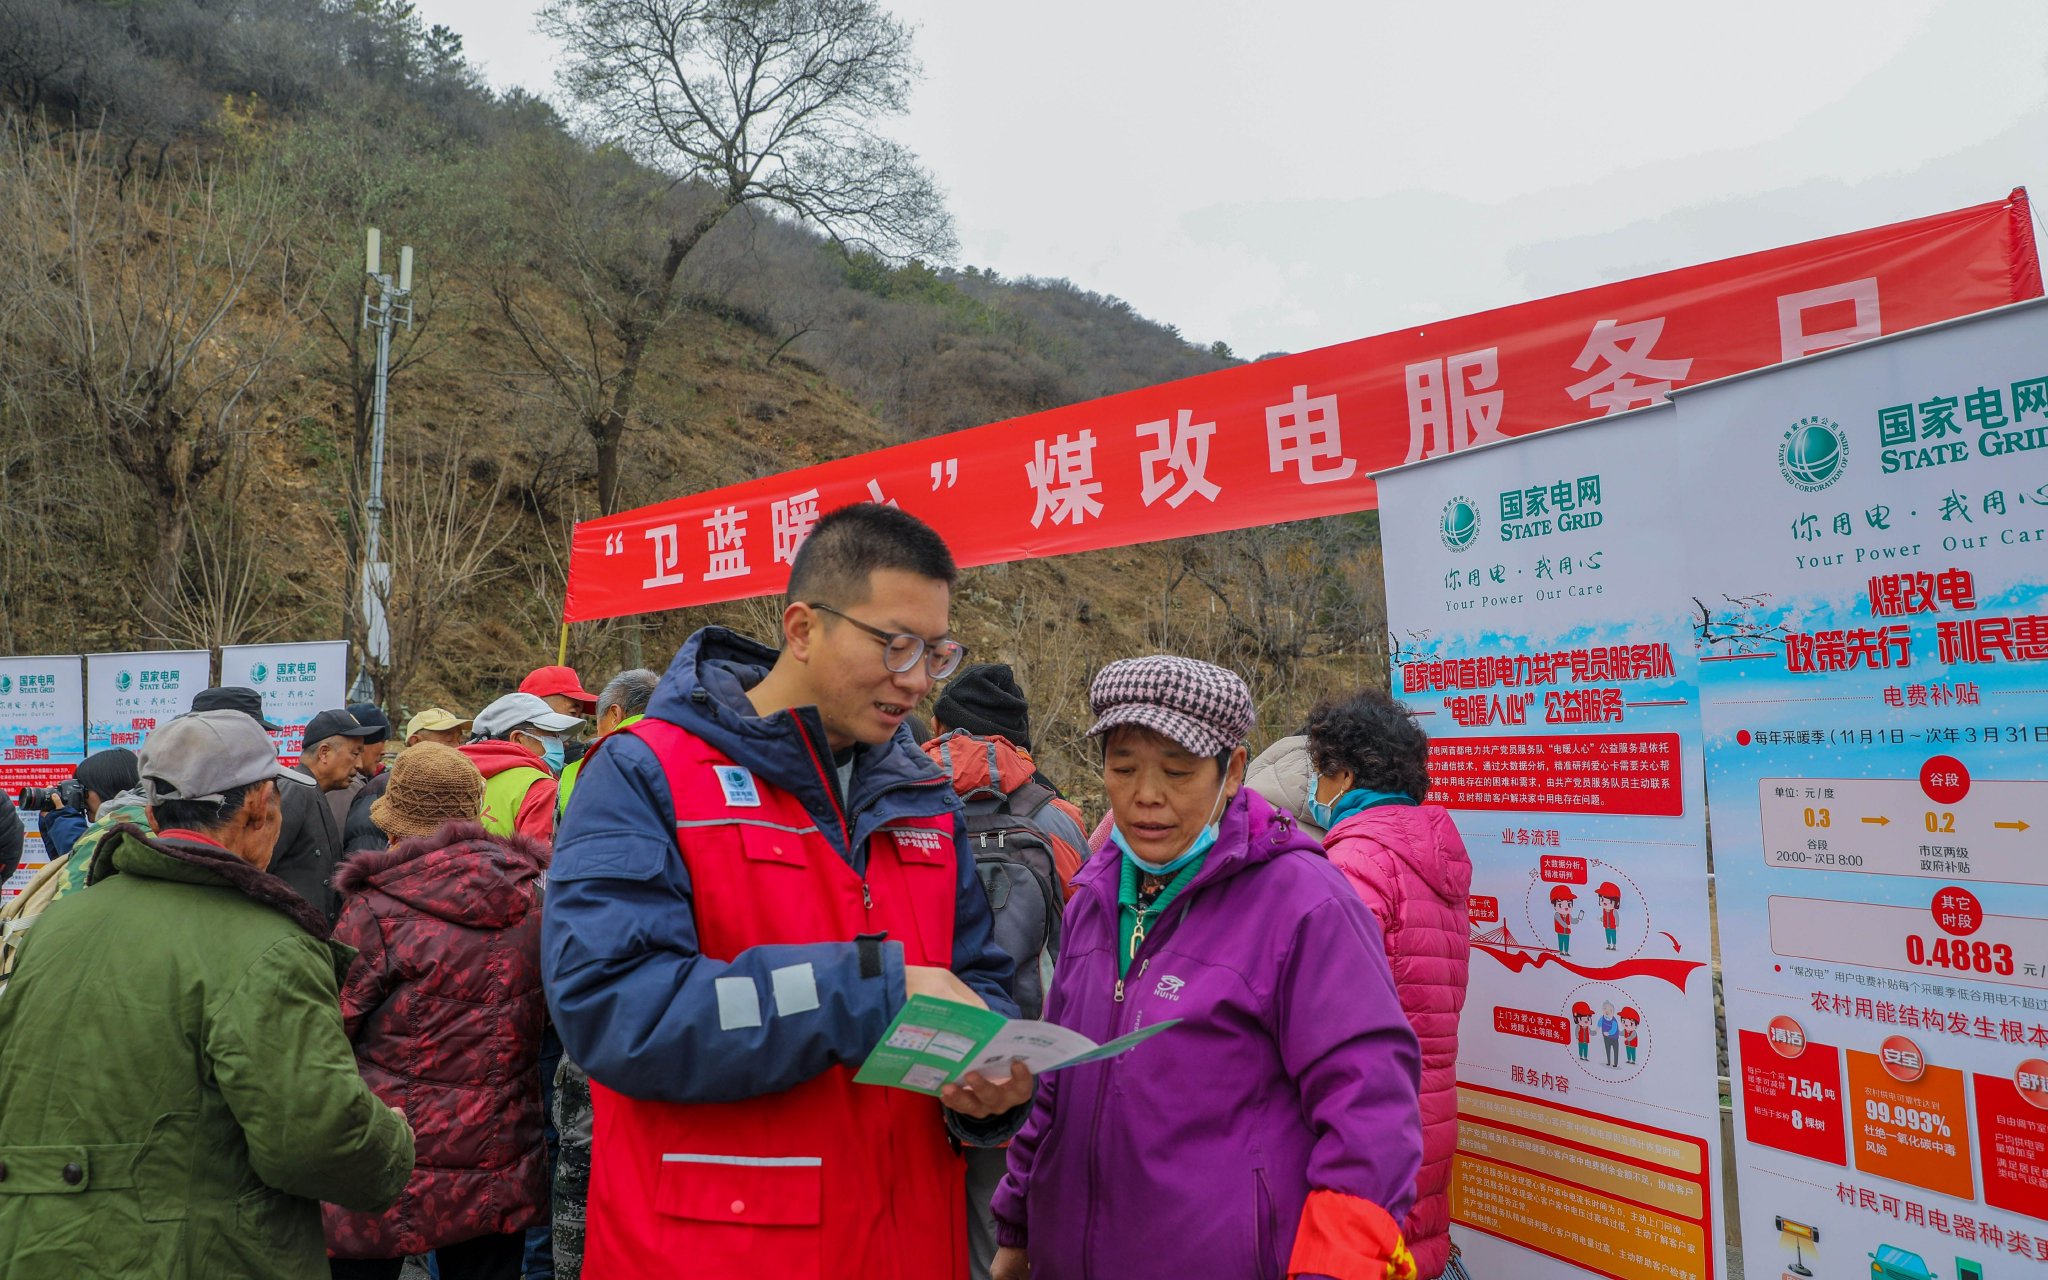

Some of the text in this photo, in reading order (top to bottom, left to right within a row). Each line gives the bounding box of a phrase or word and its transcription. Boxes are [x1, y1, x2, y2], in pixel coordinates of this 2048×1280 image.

[1877, 376, 2048, 447] 国家电网
[1881, 441, 1969, 475] STATE
[1499, 474, 1602, 521] 国家电网
[1500, 511, 1603, 542] STATE GRID
[1796, 553, 1844, 570] Your
[1855, 543, 1921, 563] Power
[1943, 535, 1988, 552] Our
[1445, 584, 1603, 612] Your Power Our Care
[1868, 568, 1976, 617] 煤改电
[1785, 624, 1911, 672] 政策先行
[140, 670, 180, 682] 国家电网
[277, 662, 316, 675] 国家电网
[1403, 642, 1676, 693] 国家电网首都电力共产党员服务队
[19, 675, 55, 687] 国家电网
[161, 682, 179, 690] GRID
[276, 674, 316, 683] STATE GRID
[1883, 682, 1980, 708] 电费补贴
[1930, 772, 1960, 787] 谷段
[1804, 808, 1831, 828] 0.3
[1925, 811, 1956, 833] 0.2
[1501, 827, 1560, 848] 业务流程
[1806, 839, 1829, 850] 谷段
[1919, 845, 1969, 859] 市区两级
[1544, 870, 1574, 880] 精准研判
[1920, 860, 1971, 874] 政府补贴
[1940, 894, 1970, 911] 其它
[1941, 913, 1973, 929] 时段
[1906, 934, 2014, 976] 0.4883
[1153, 988, 1180, 1001] HUIYU
[1811, 991, 2048, 1048] 农村用能结构发生根本
[1770, 1026, 1803, 1047] 清洁
[1883, 1048, 1920, 1069] 安全
[1511, 1064, 1569, 1094] 服务内容
[1788, 1075, 1836, 1102] 7.54 吨
[1791, 1109, 1803, 1130] 8
[1804, 1116, 1826, 1132] 棵树
[1865, 1099, 1951, 1138] 99.993%
[1864, 1123, 1957, 1157] 杜绝一氧化碳中毒
[1865, 1140, 1888, 1157] 风险
